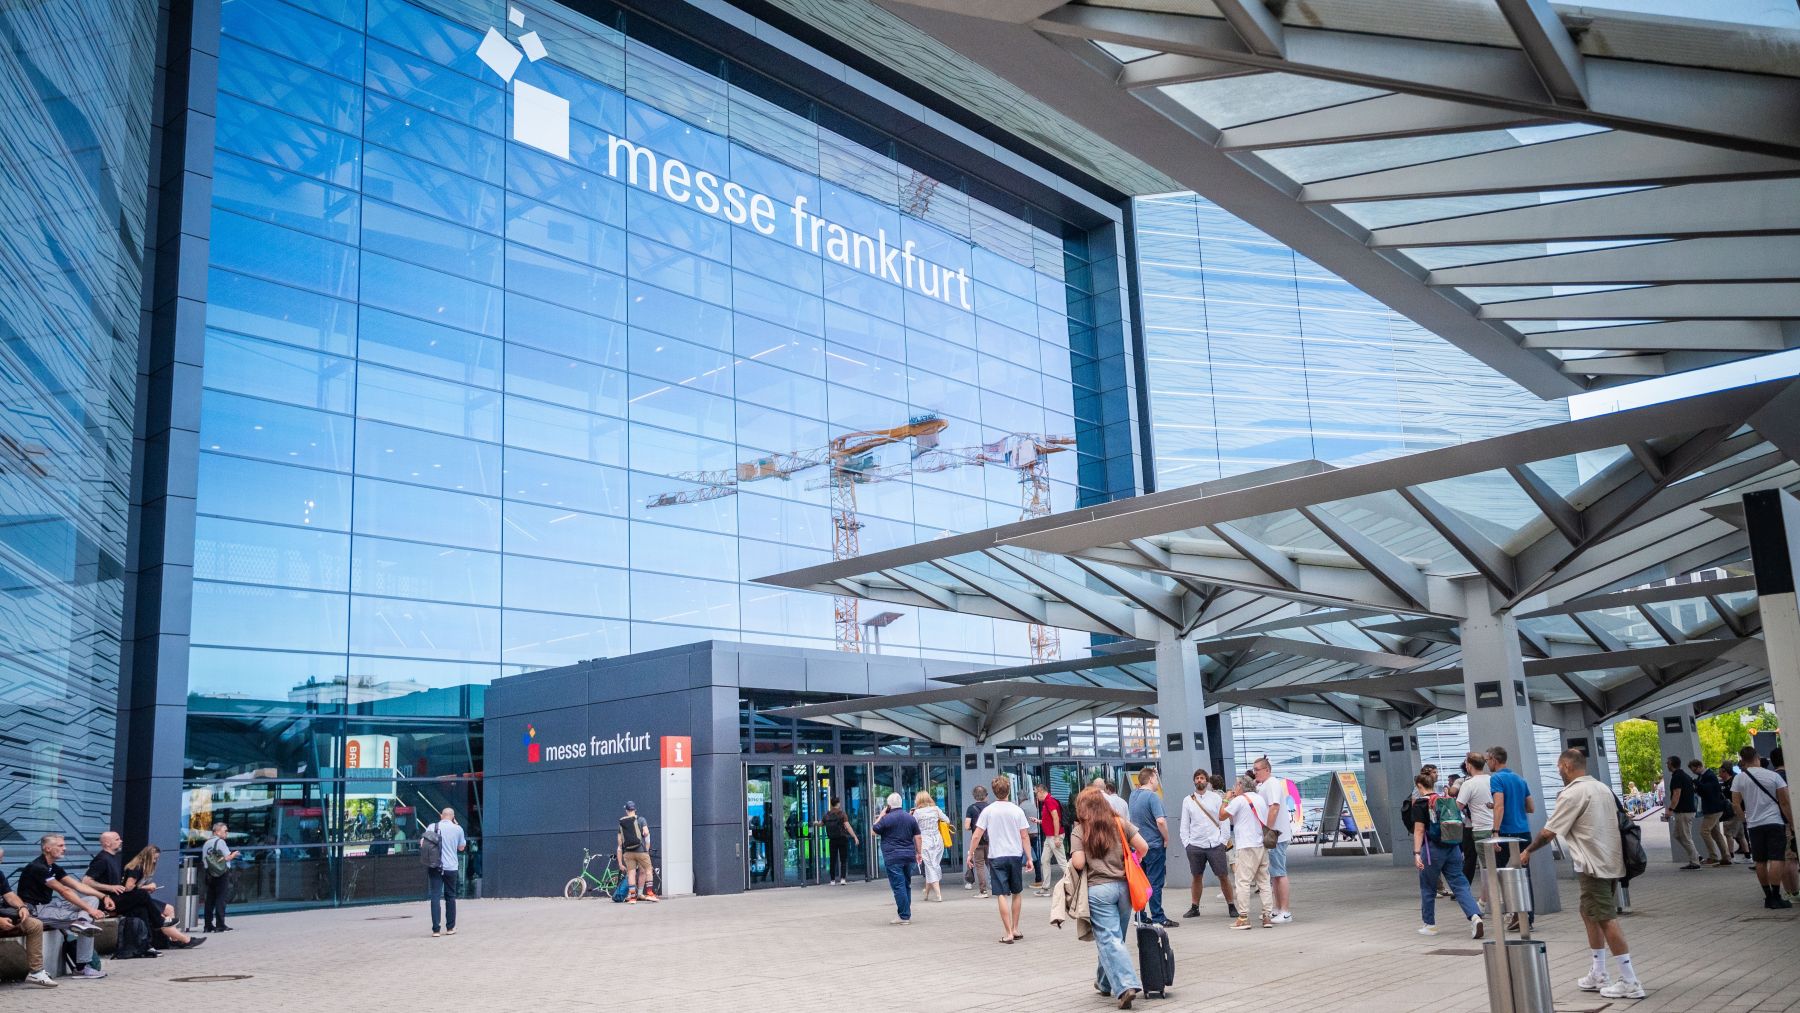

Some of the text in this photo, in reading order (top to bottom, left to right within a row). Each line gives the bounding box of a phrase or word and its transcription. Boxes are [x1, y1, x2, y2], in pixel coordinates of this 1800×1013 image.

[608, 134, 971, 311] messe frankfurt
[349, 746, 357, 768] BAF
[545, 731, 651, 762] messe frankfurt
